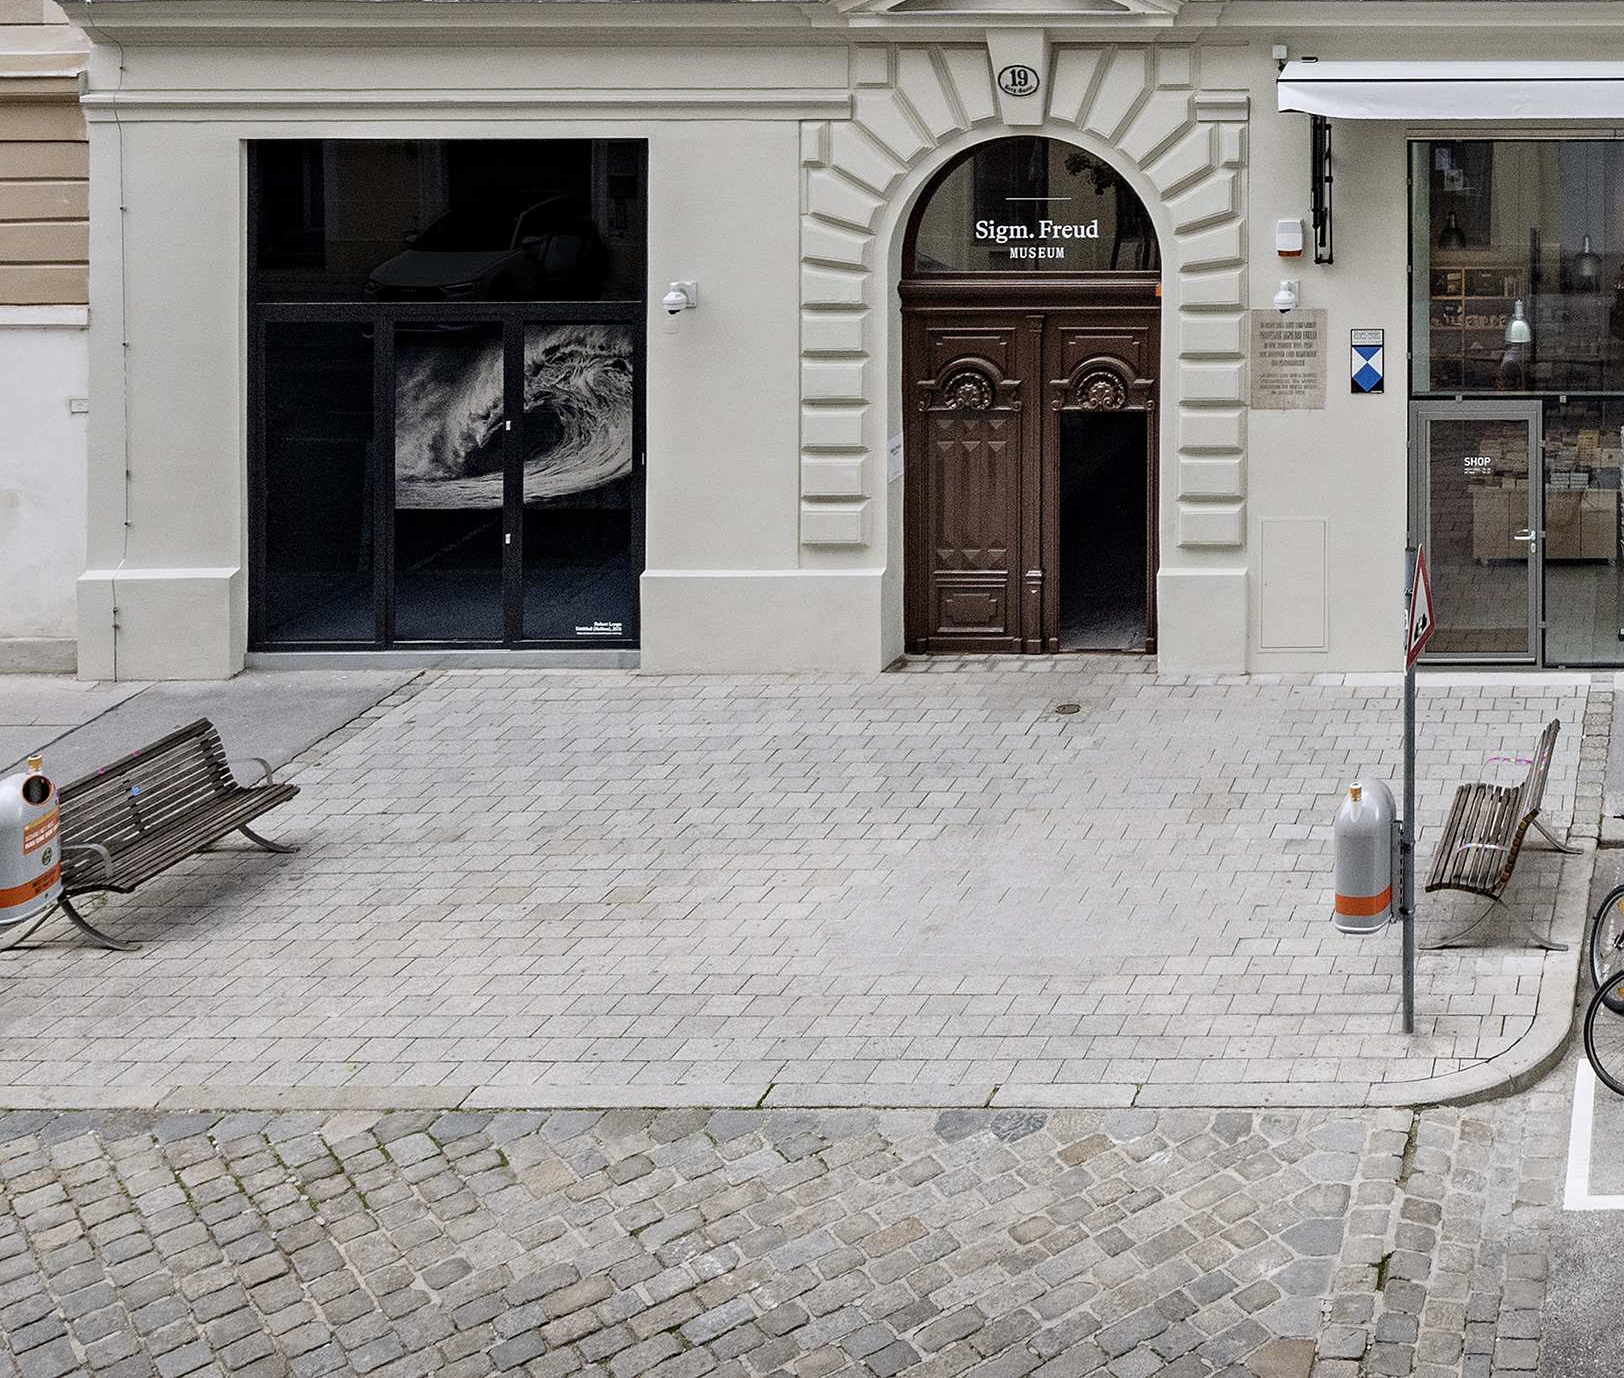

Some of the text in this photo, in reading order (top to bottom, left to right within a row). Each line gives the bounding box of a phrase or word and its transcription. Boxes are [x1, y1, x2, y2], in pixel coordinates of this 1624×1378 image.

[1010, 69, 1028, 87] 19
[975, 219, 1100, 244] Sigm. Freud
[1009, 246, 1065, 259] MUSEUM
[1464, 456, 1491, 467] SHOP
